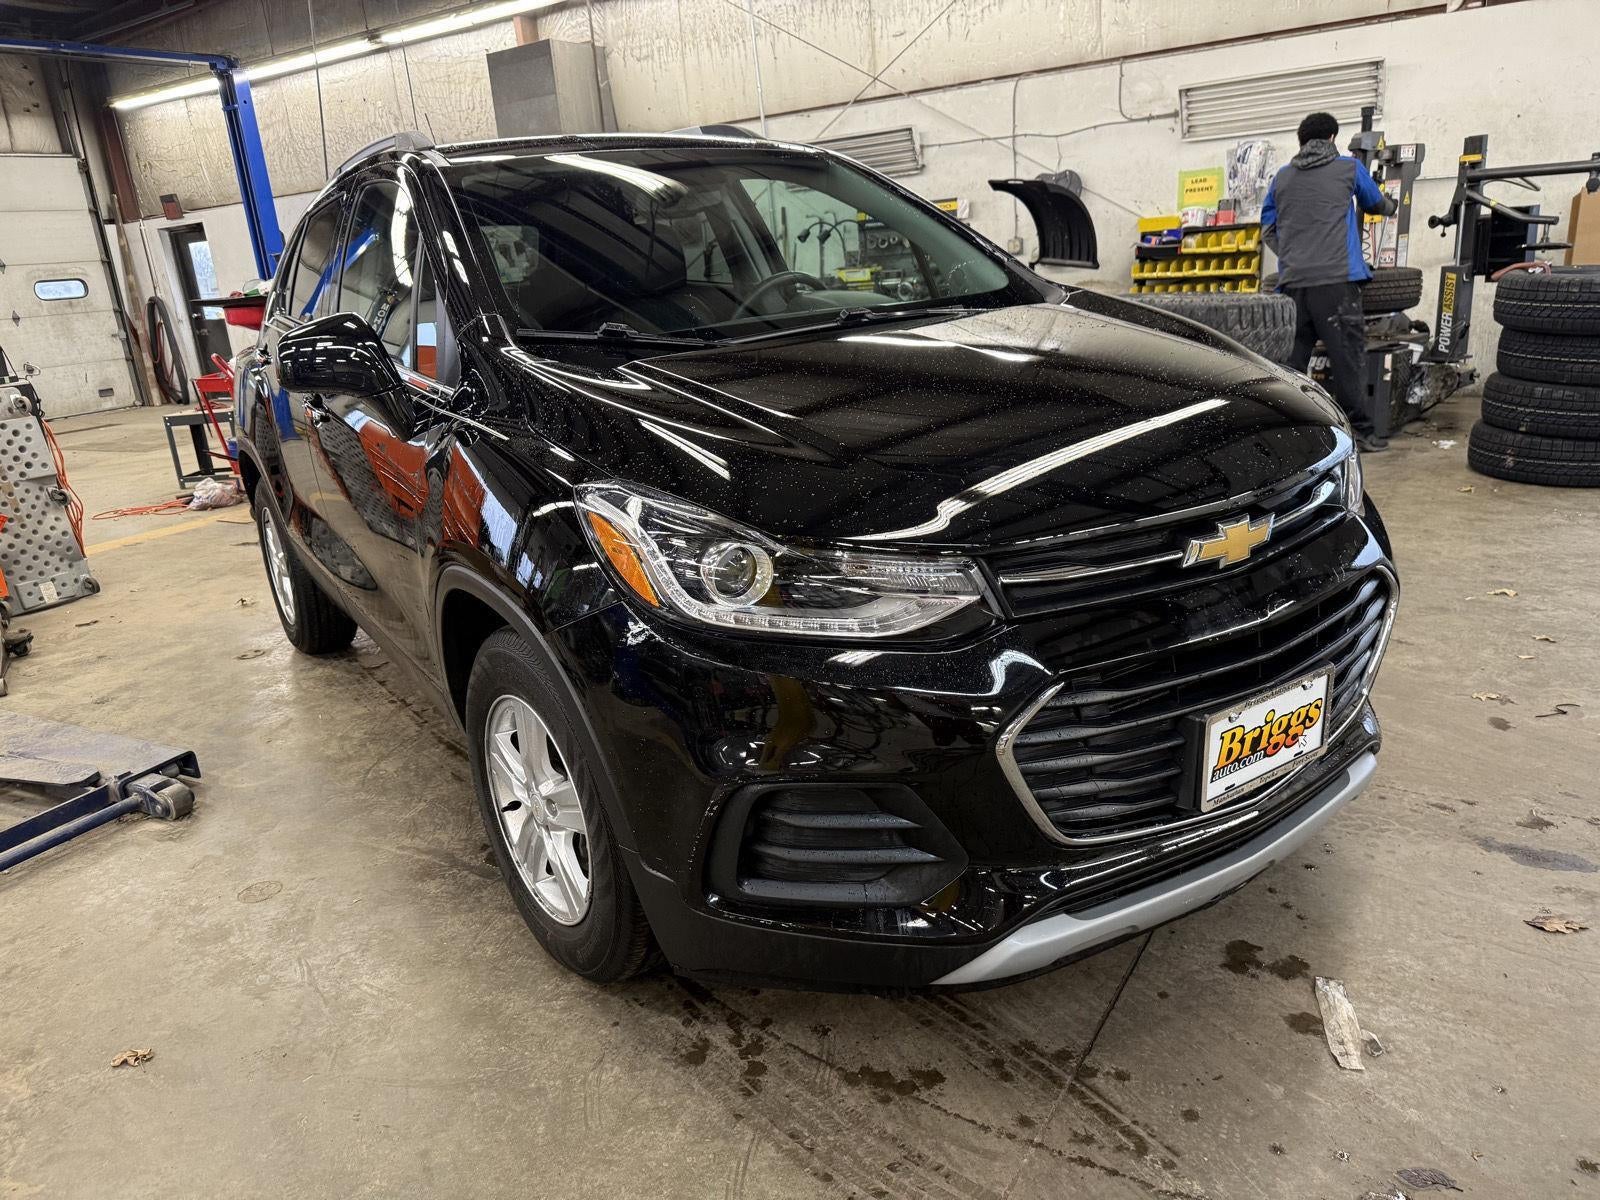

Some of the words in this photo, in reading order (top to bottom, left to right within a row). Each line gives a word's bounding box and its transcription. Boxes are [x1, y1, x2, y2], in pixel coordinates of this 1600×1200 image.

[1443, 274, 1456, 311] ASSIST
[1438, 312, 1453, 353] POWER
[1215, 697, 1324, 770] Briggs
[1212, 750, 1264, 782] auto.com
